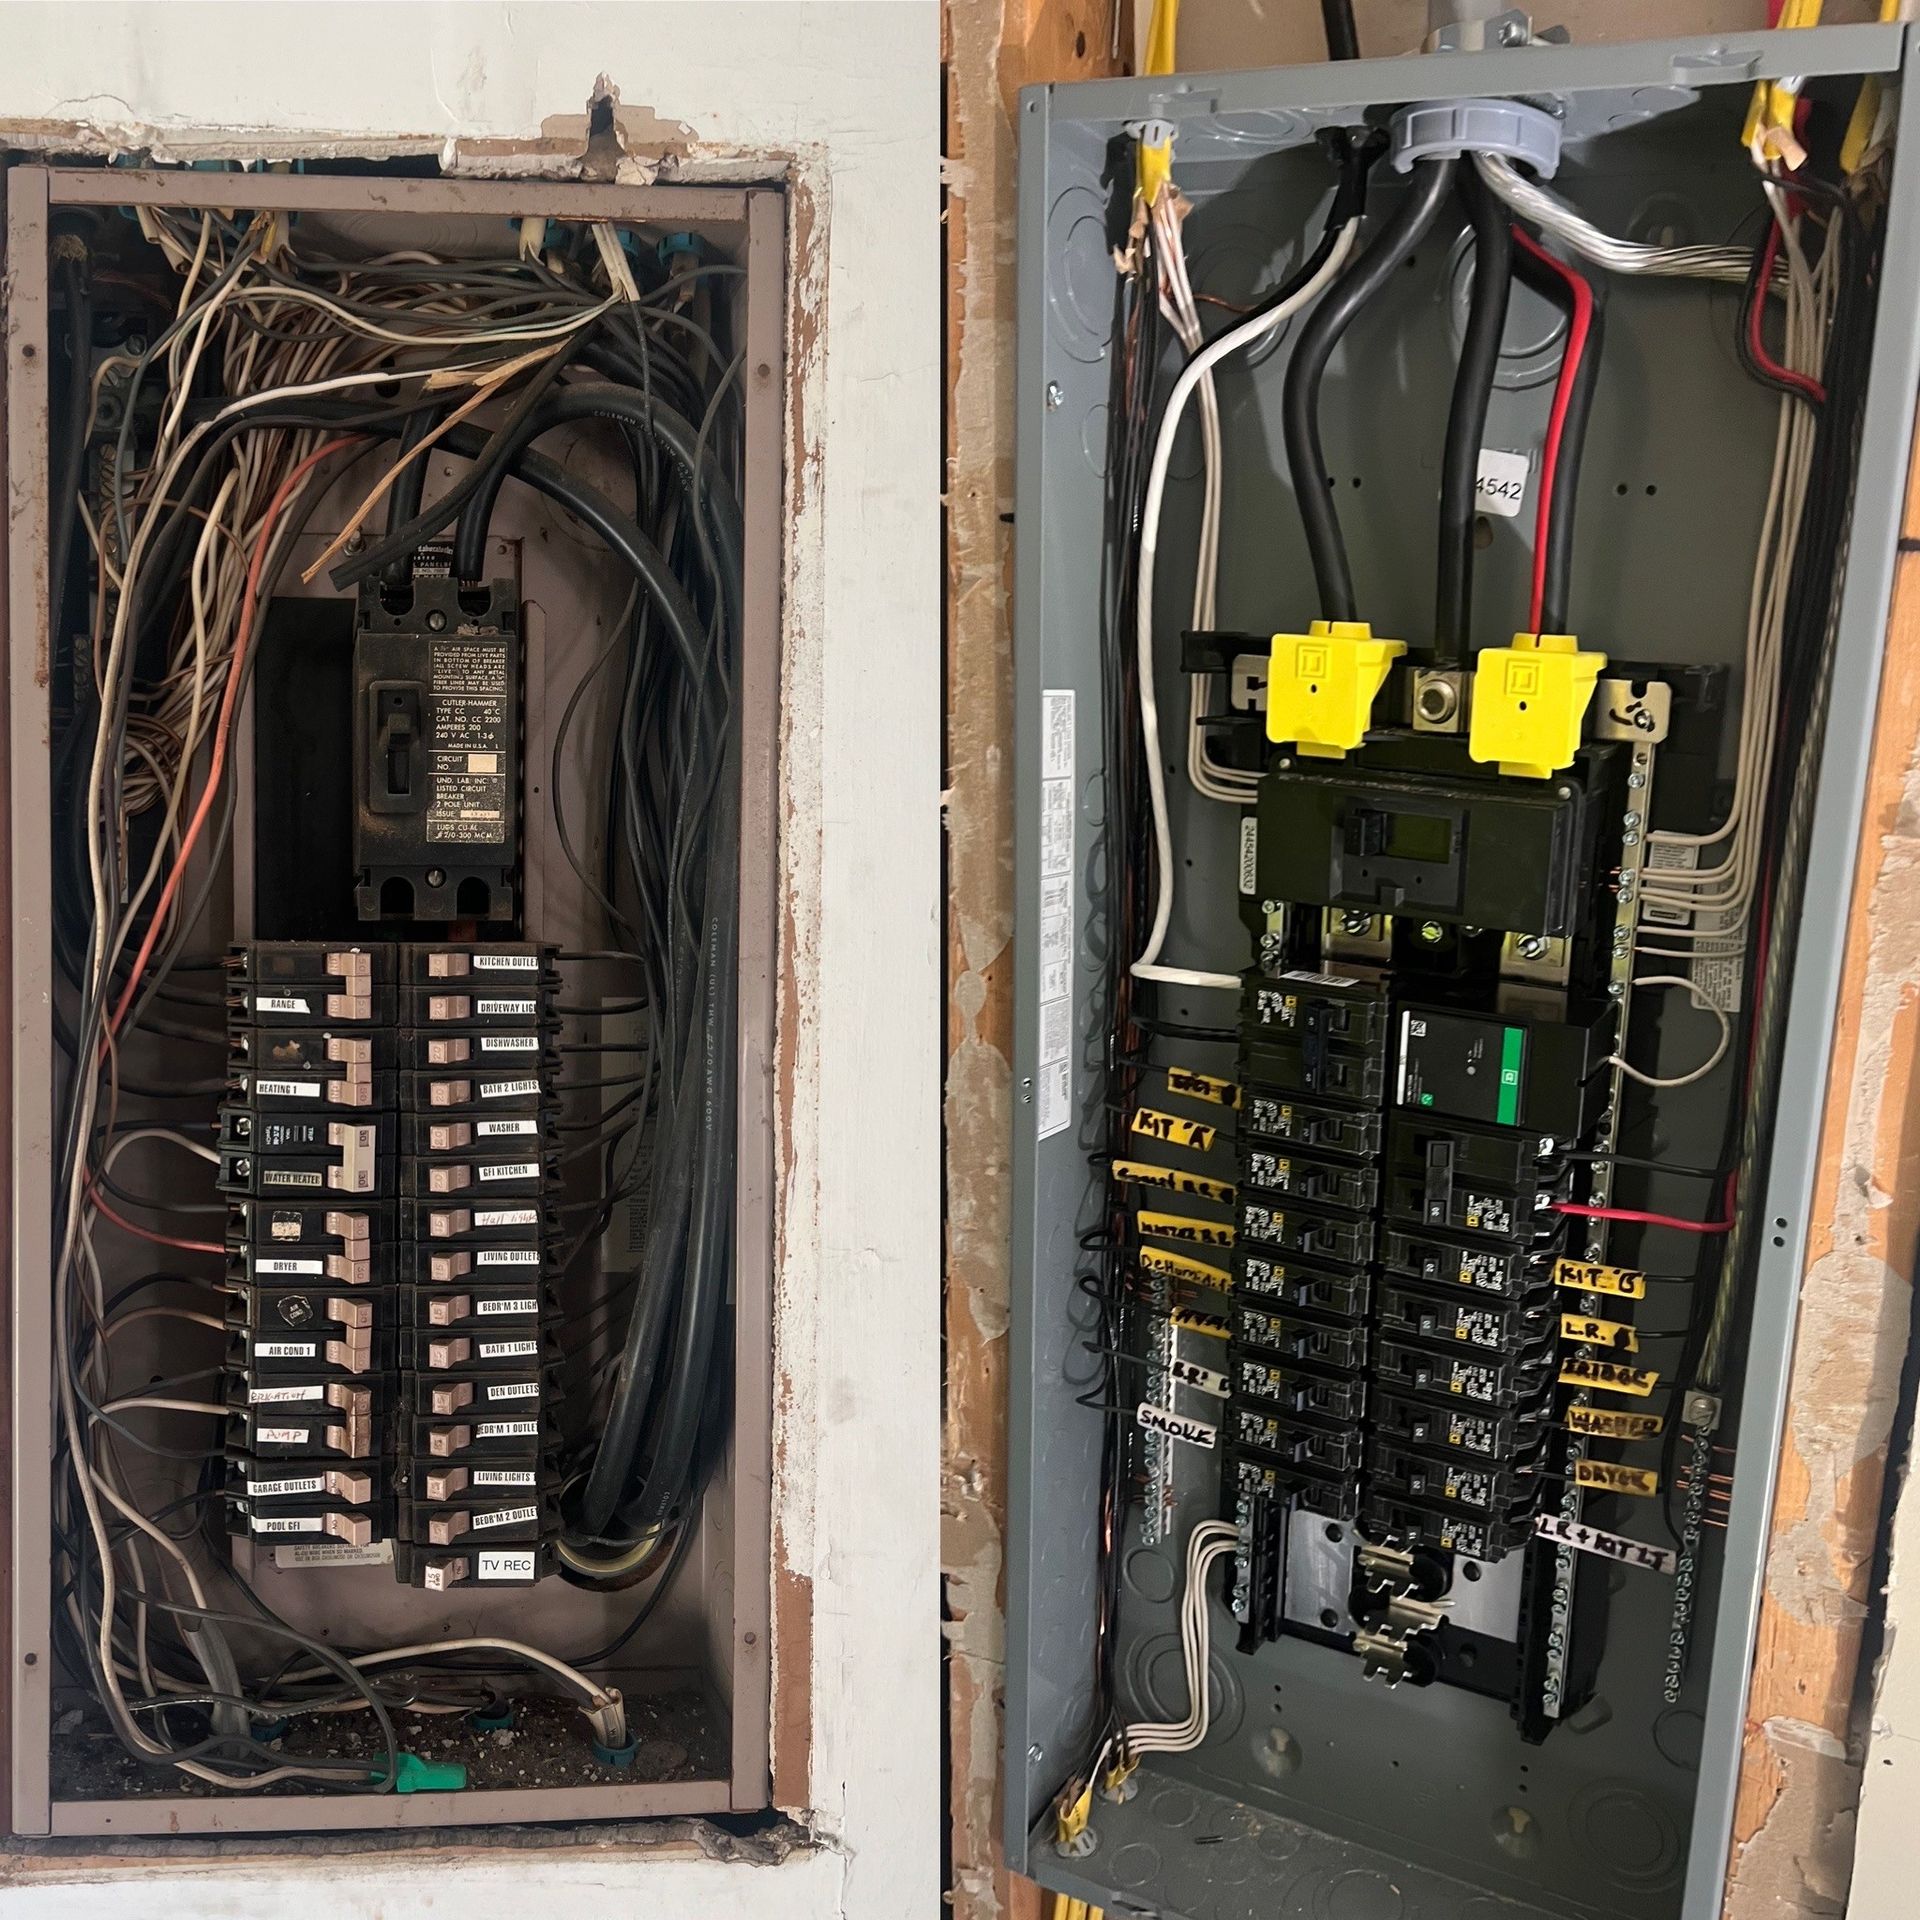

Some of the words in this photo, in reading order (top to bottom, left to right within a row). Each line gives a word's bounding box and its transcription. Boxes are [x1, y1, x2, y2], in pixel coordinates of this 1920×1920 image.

[594, 410, 637, 425] COLEMAN
[710, 917, 718, 967] COLEMAN
[480, 957, 510, 966] KITCHEN
[271, 999, 295, 1009] RANGE
[481, 1003, 519, 1012] DRIVEWAY
[706, 1003, 714, 1026] THW
[486, 1039, 534, 1047] DISHWASHER
[259, 1083, 290, 1094] HEATING
[293, 1085, 297, 1094] 1
[483, 1085, 502, 1094] BATH
[504, 1084, 509, 1092] 2
[512, 1082, 537, 1091] LIGHTS
[489, 1123, 520, 1132] WASHER
[1139, 1110, 1174, 1139] KIT
[360, 1130, 367, 1141] 30
[483, 1168, 495, 1176] GFI
[497, 1166, 528, 1175] KITCHEN
[265, 1173, 291, 1183] WATER
[293, 1174, 320, 1185] HEATER
[358, 1174, 366, 1187] 30
[274, 1262, 297, 1271] DRYER
[1560, 1264, 1603, 1287] KIT
[513, 1302, 518, 1310] 3
[269, 1346, 282, 1355] AIR
[284, 1347, 304, 1355] COND
[307, 1347, 310, 1355] 1
[486, 1345, 505, 1354] BATH
[508, 1344, 511, 1352] 1
[491, 1387, 505, 1396] DEN
[508, 1385, 539, 1395] OUTLETS
[507, 1424, 510, 1433] 1
[1140, 1410, 1213, 1445] SMOKE
[267, 1430, 302, 1440] PUMP
[478, 1472, 502, 1481] LIVING
[505, 1473, 530, 1481] LIGHTS
[253, 1482, 282, 1493] GARAGE
[284, 1480, 316, 1492] OUTLETS
[506, 1512, 510, 1521] 2
[267, 1522, 285, 1530] POOL
[288, 1522, 300, 1530] GFI
[482, 1560, 499, 1570] TV
[504, 1560, 531, 1570] REC
[428, 1574, 436, 1585] 15
